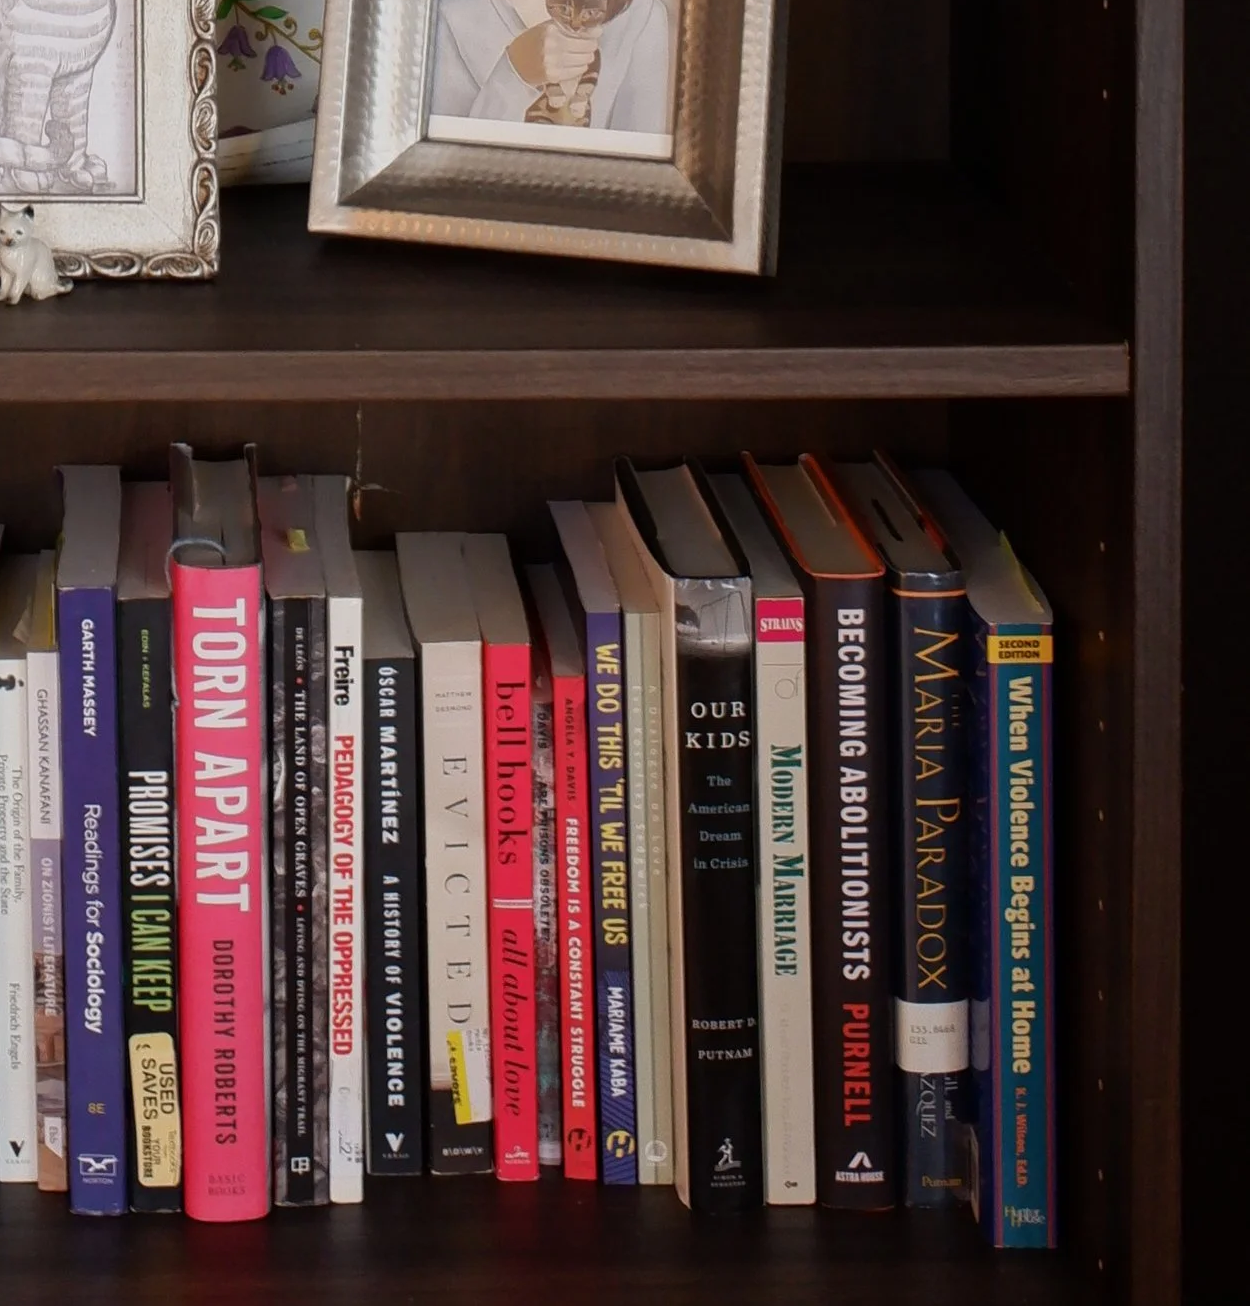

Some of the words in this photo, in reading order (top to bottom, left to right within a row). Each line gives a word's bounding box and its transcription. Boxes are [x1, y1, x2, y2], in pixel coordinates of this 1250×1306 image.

[80, 618, 95, 672] GARTH
[192, 597, 247, 729] TORN
[333, 645, 355, 707] Freire
[837, 608, 868, 758] BECOMING
[82, 674, 97, 737] MASSEY
[913, 626, 959, 781] MARIA
[1008, 675, 1034, 752] When
[332, 734, 355, 848] PEDAGOGY
[1009, 759, 1035, 868] Violence
[80, 803, 103, 895] Readings
[194, 751, 250, 912] APART
[333, 852, 354, 880] OF
[333, 884, 354, 926] THE
[382, 875, 400, 885] A
[840, 766, 871, 981] ABOLITIONISTS
[915, 798, 960, 989] PARADOX
[85, 899, 105, 928] for
[382, 891, 401, 958] HISTORY
[501, 928, 528, 968] all
[1006, 875, 1036, 960] Begins
[83, 930, 106, 1034] Sociology
[332, 931, 355, 1056] OPPRESSED
[384, 965, 402, 984] OF
[502, 973, 529, 1053] about
[1011, 966, 1035, 993] at
[385, 991, 405, 1107] VIOLENCE
[1011, 1000, 1036, 1074] Home
[503, 1059, 530, 1117] love
